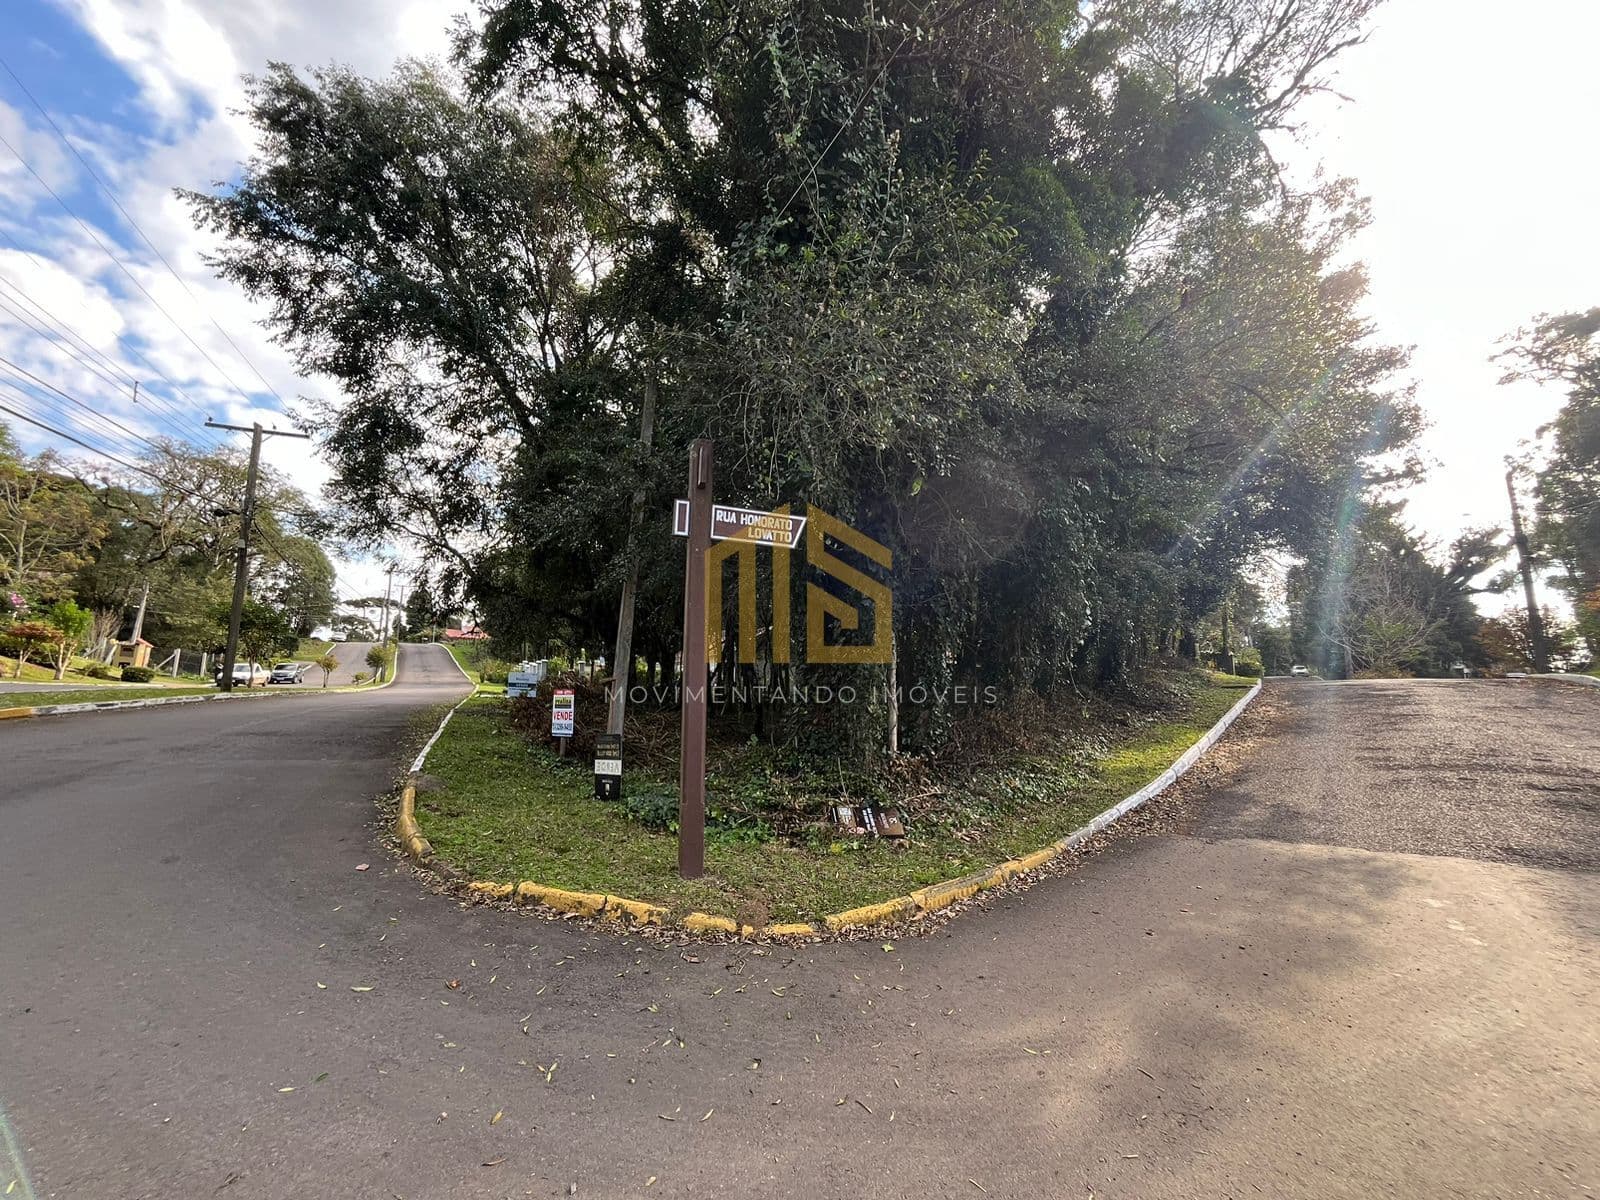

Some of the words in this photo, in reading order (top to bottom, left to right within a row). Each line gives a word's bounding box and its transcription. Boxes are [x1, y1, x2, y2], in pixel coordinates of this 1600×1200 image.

[715, 510, 737, 524] RUA
[740, 513, 793, 531] HONORATO
[747, 527, 793, 543] LOVATTO
[553, 711, 573, 721] VENDE
